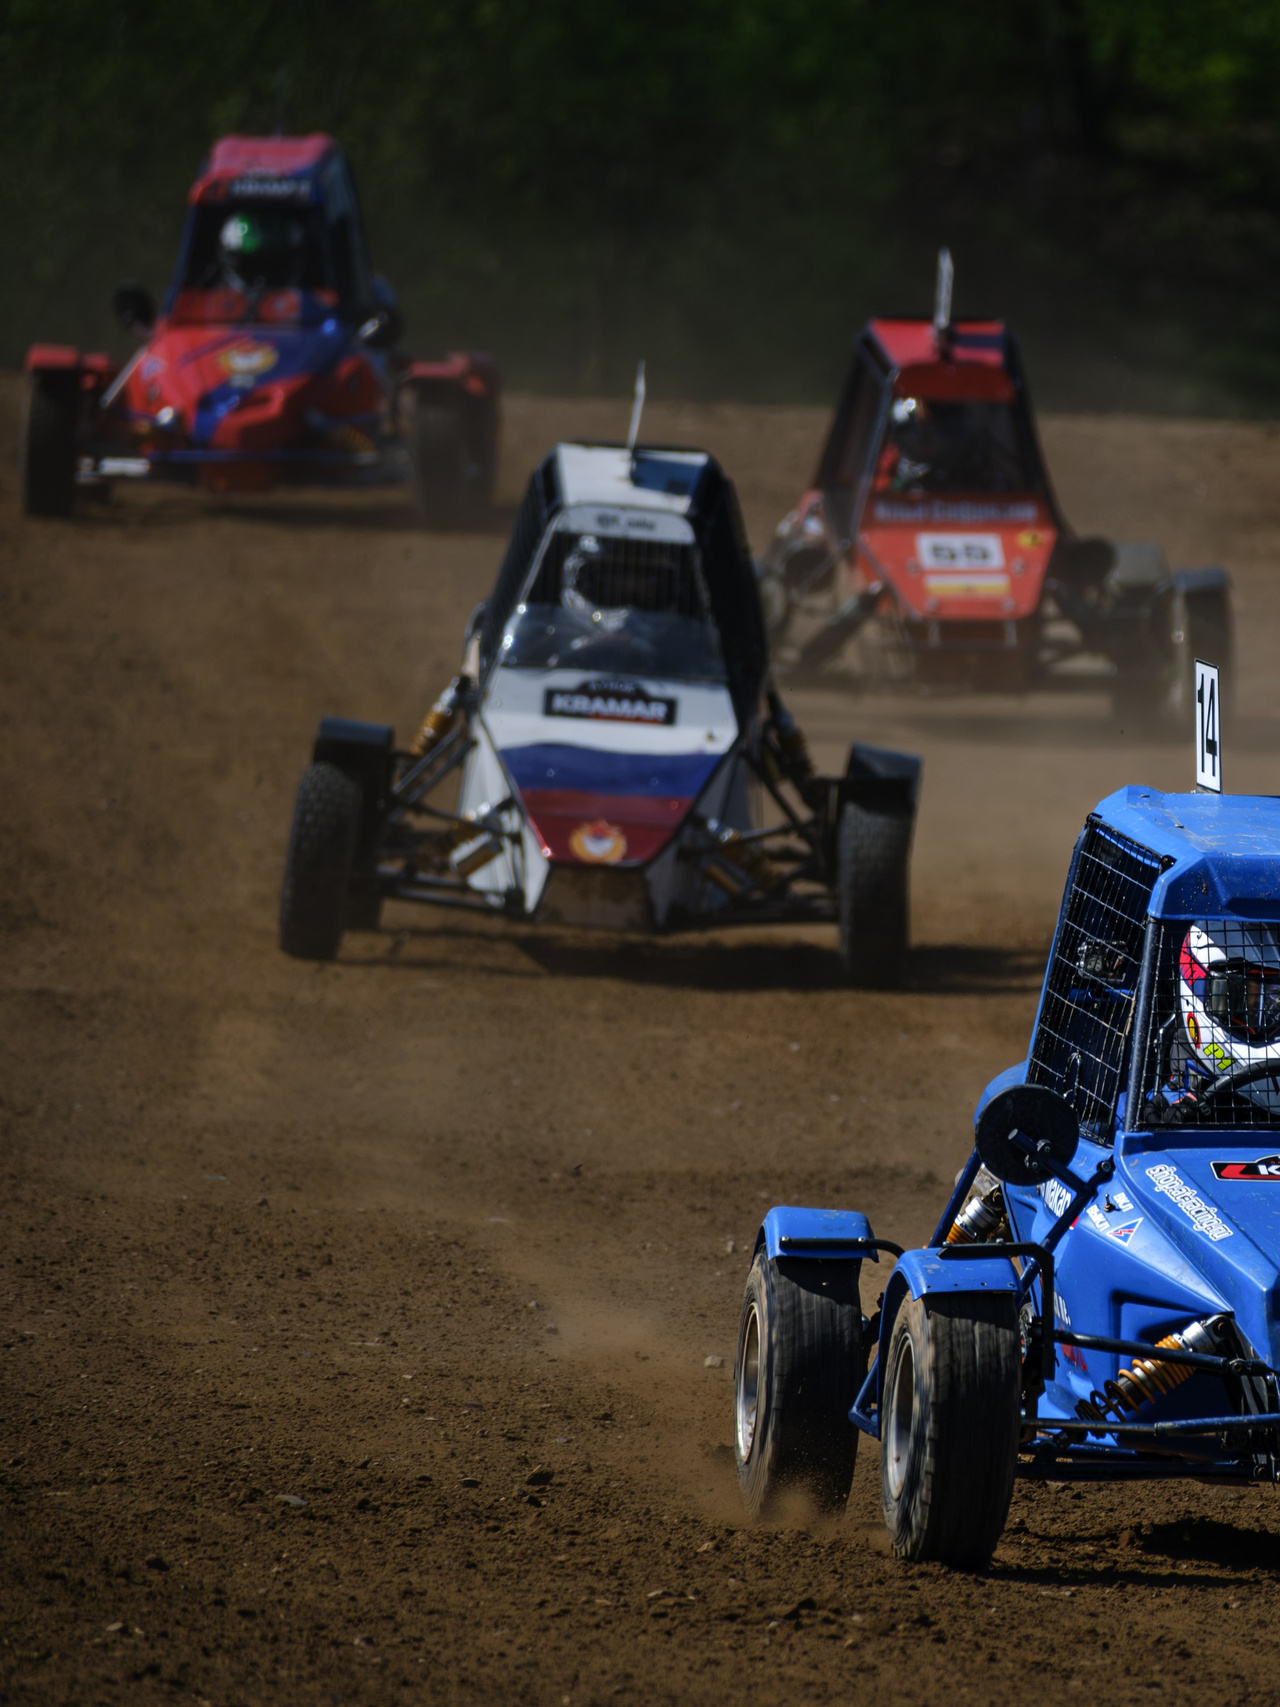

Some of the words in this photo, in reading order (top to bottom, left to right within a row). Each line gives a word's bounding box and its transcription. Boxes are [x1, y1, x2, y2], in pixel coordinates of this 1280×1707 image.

[552, 694, 668, 721] KRAMAR
[1197, 673, 1217, 777] 14
[1112, 1192, 1135, 1213] ВКЛ
[1086, 1204, 1111, 1233] ВЫКЛ
